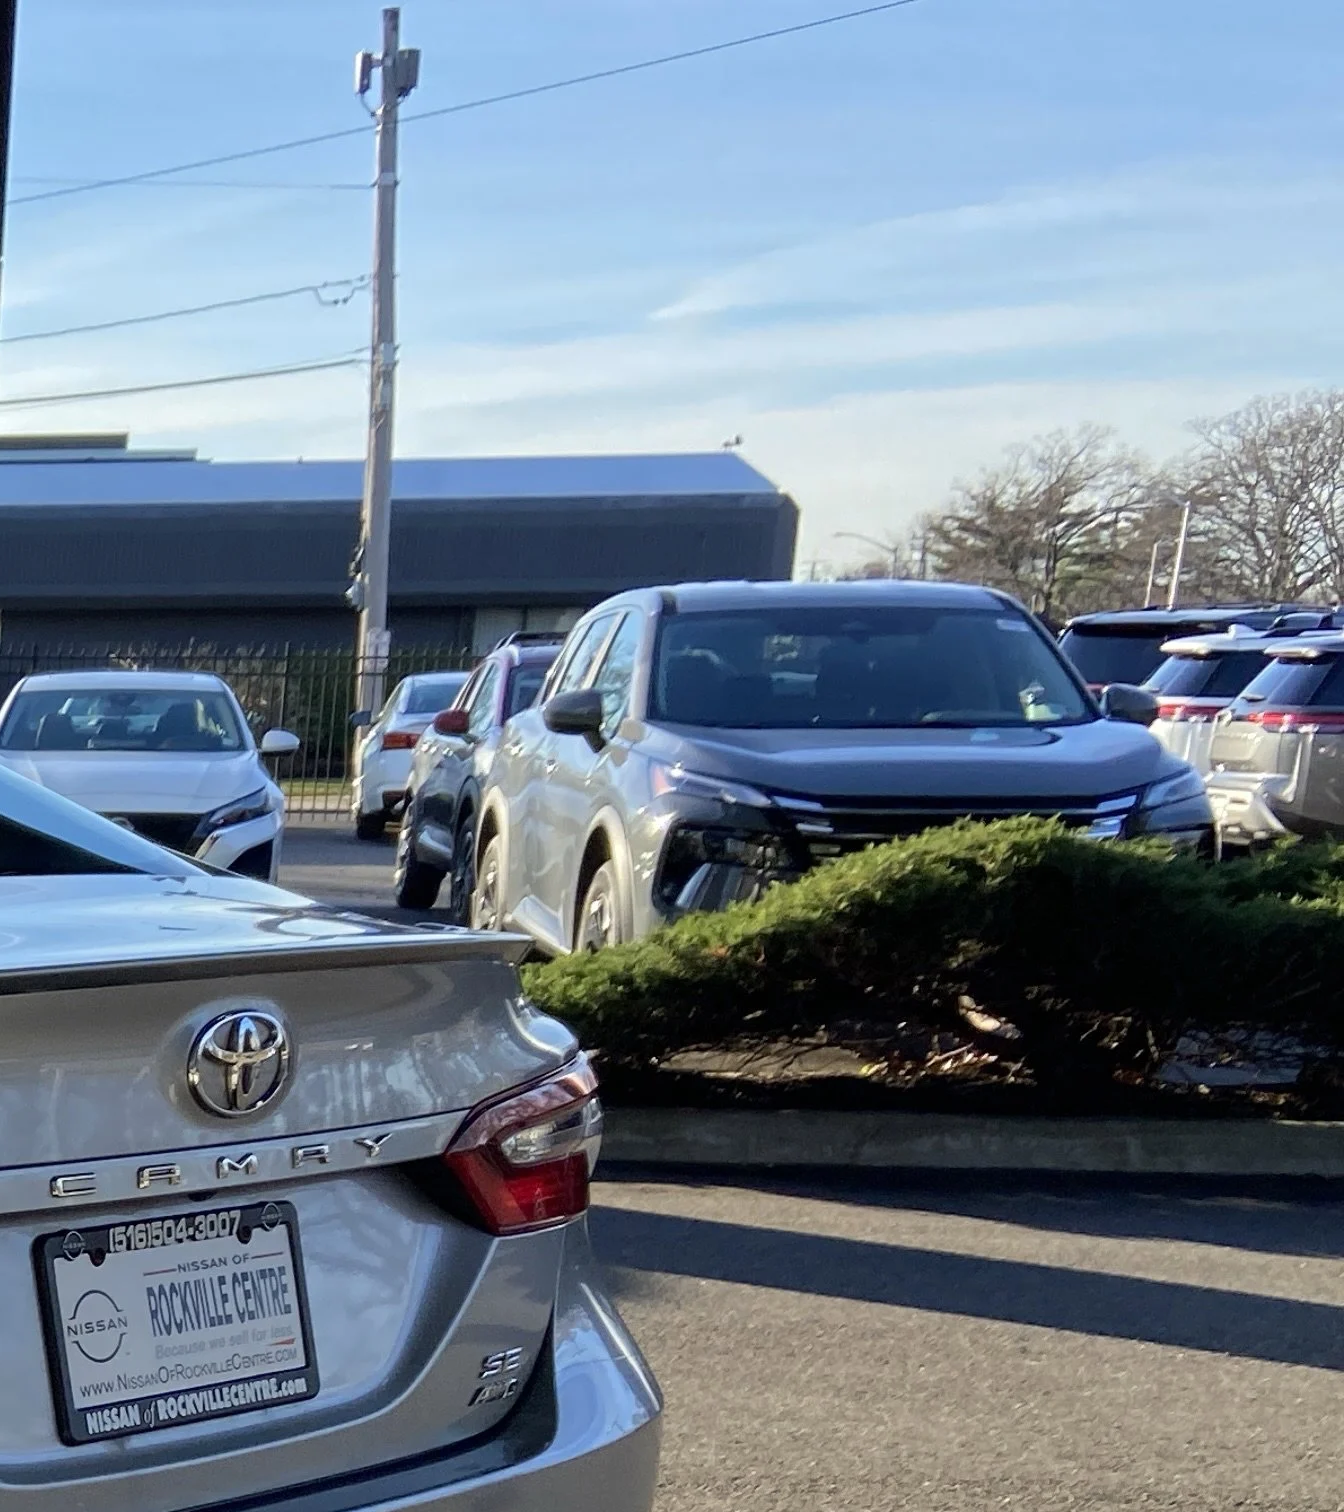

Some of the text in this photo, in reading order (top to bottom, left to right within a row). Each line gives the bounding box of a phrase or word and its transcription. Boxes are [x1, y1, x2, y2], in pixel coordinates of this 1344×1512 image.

[50, 1133, 393, 1197] CAMRY
[109, 1210, 241, 1252] (516)504-3007
[177, 1253, 250, 1272] NISSAN OF
[146, 1266, 292, 1337] ROCKVILLE CENTRE
[67, 1316, 128, 1336] NISSAN
[155, 1341, 206, 1360] Because
[209, 1336, 226, 1348] we
[229, 1330, 249, 1346] sell
[252, 1327, 268, 1341] for
[478, 1346, 523, 1379] SE
[86, 1377, 308, 1435] NISSAN of ROCKVILLECENTRE.com
